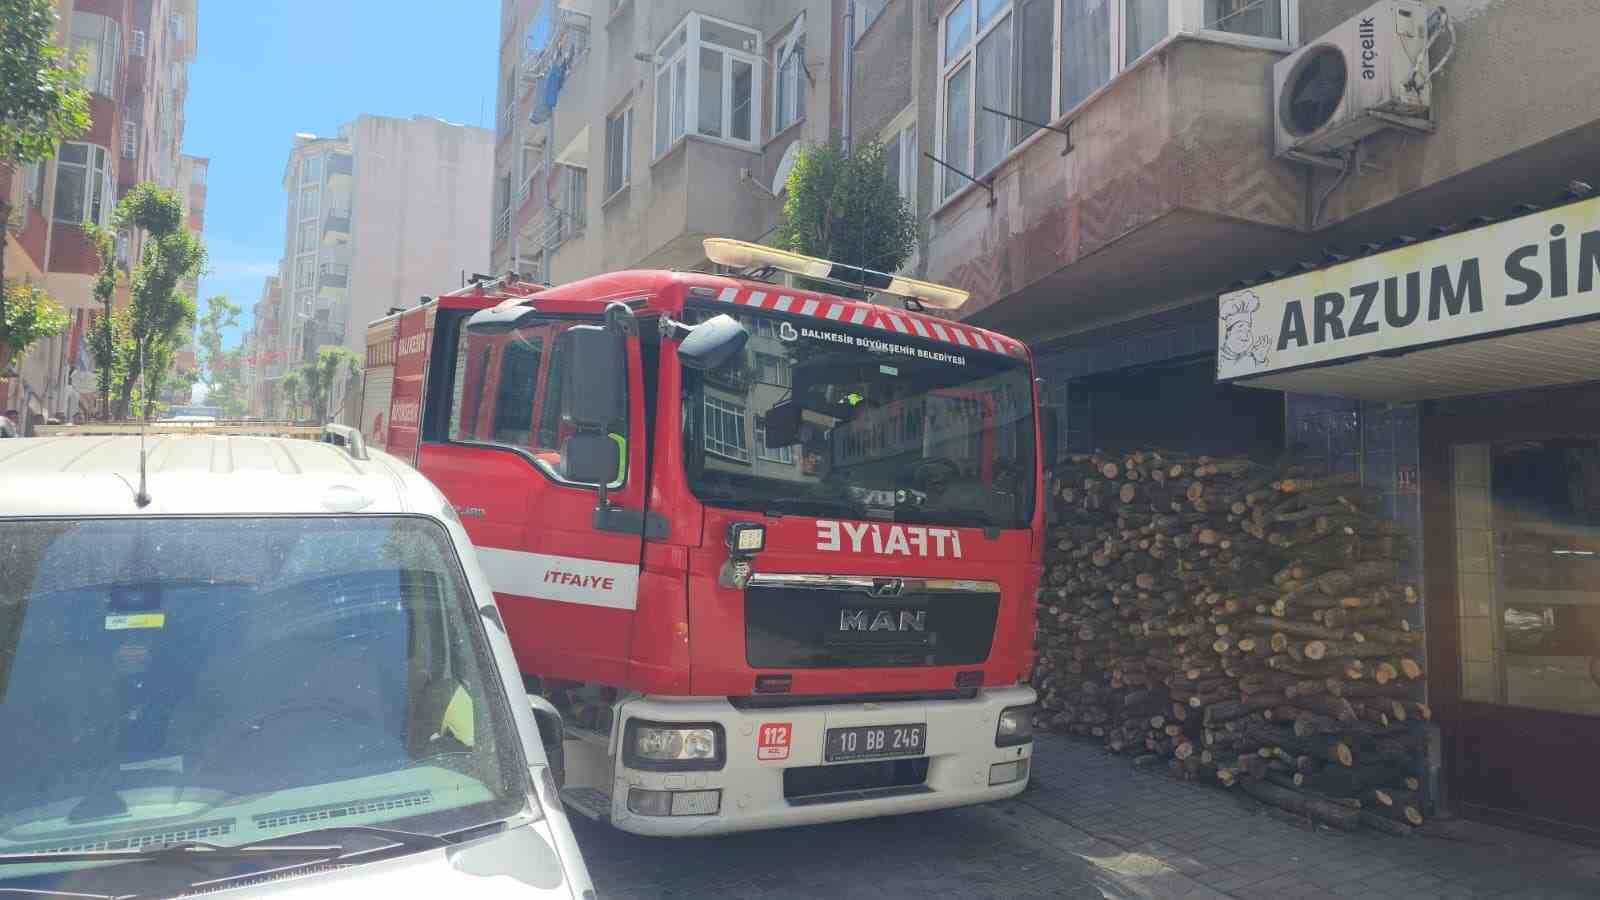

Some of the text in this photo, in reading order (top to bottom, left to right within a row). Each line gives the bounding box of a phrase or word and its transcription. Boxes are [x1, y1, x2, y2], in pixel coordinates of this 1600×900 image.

[1360, 16, 1378, 80] arçelik
[1276, 257, 1483, 351] ARZUM
[801, 328, 966, 365] BALIKESİR BÜYÜKŞEHİR BELEDİYESİ
[543, 569, 614, 590] İTFAİYE
[840, 608, 927, 631] MAN
[764, 727, 787, 745] 112
[841, 729, 920, 751] 10 BB 246
